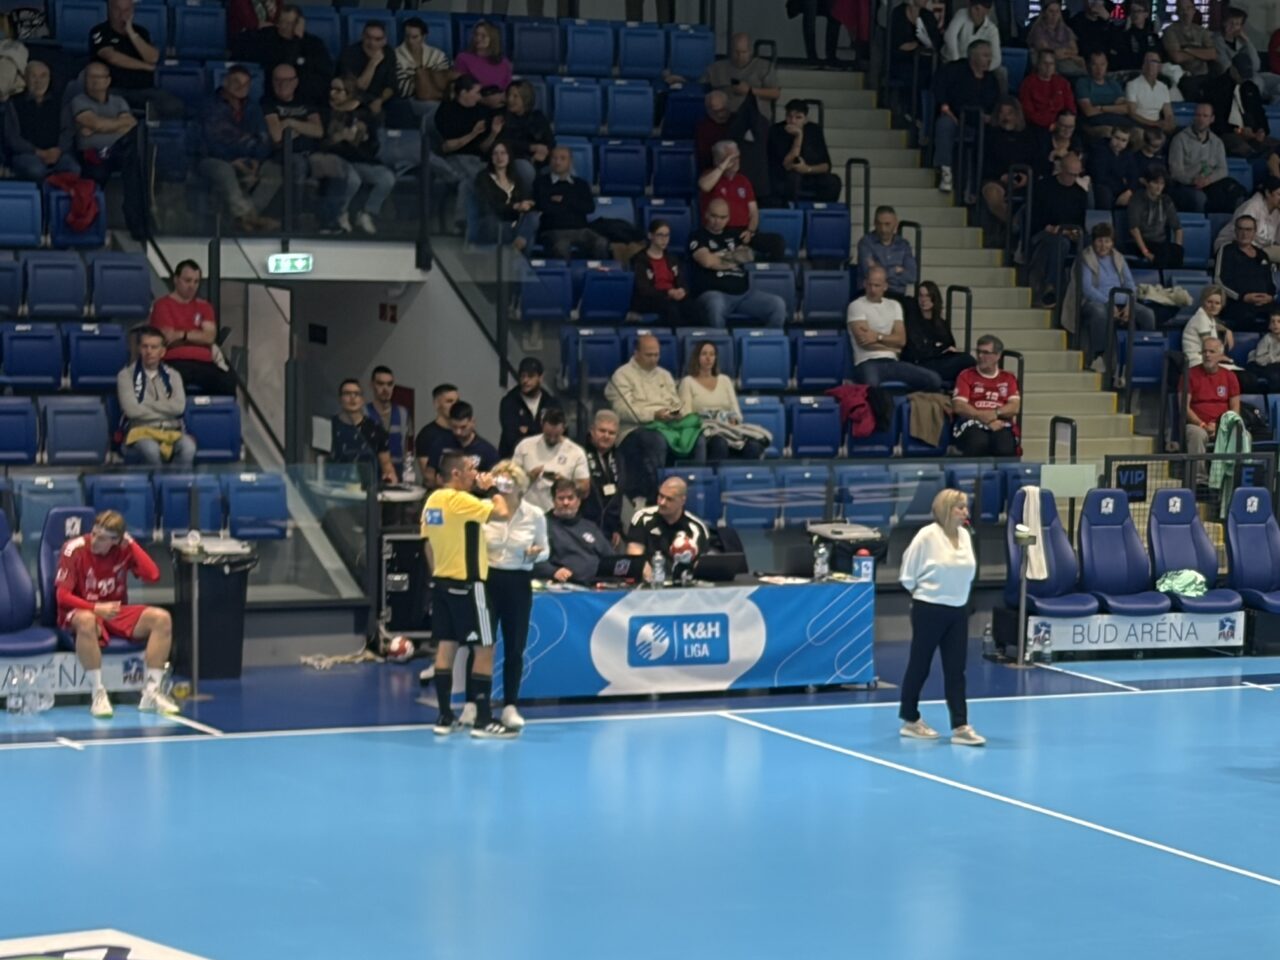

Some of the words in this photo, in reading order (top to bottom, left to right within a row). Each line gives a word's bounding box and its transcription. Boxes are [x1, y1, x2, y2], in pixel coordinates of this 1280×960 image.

[1119, 470, 1145, 486] VIP
[682, 621, 720, 640] K&H
[1071, 623, 1119, 645] BUD
[1124, 617, 1199, 643] ARÉNA
[684, 643, 710, 659] LIGA
